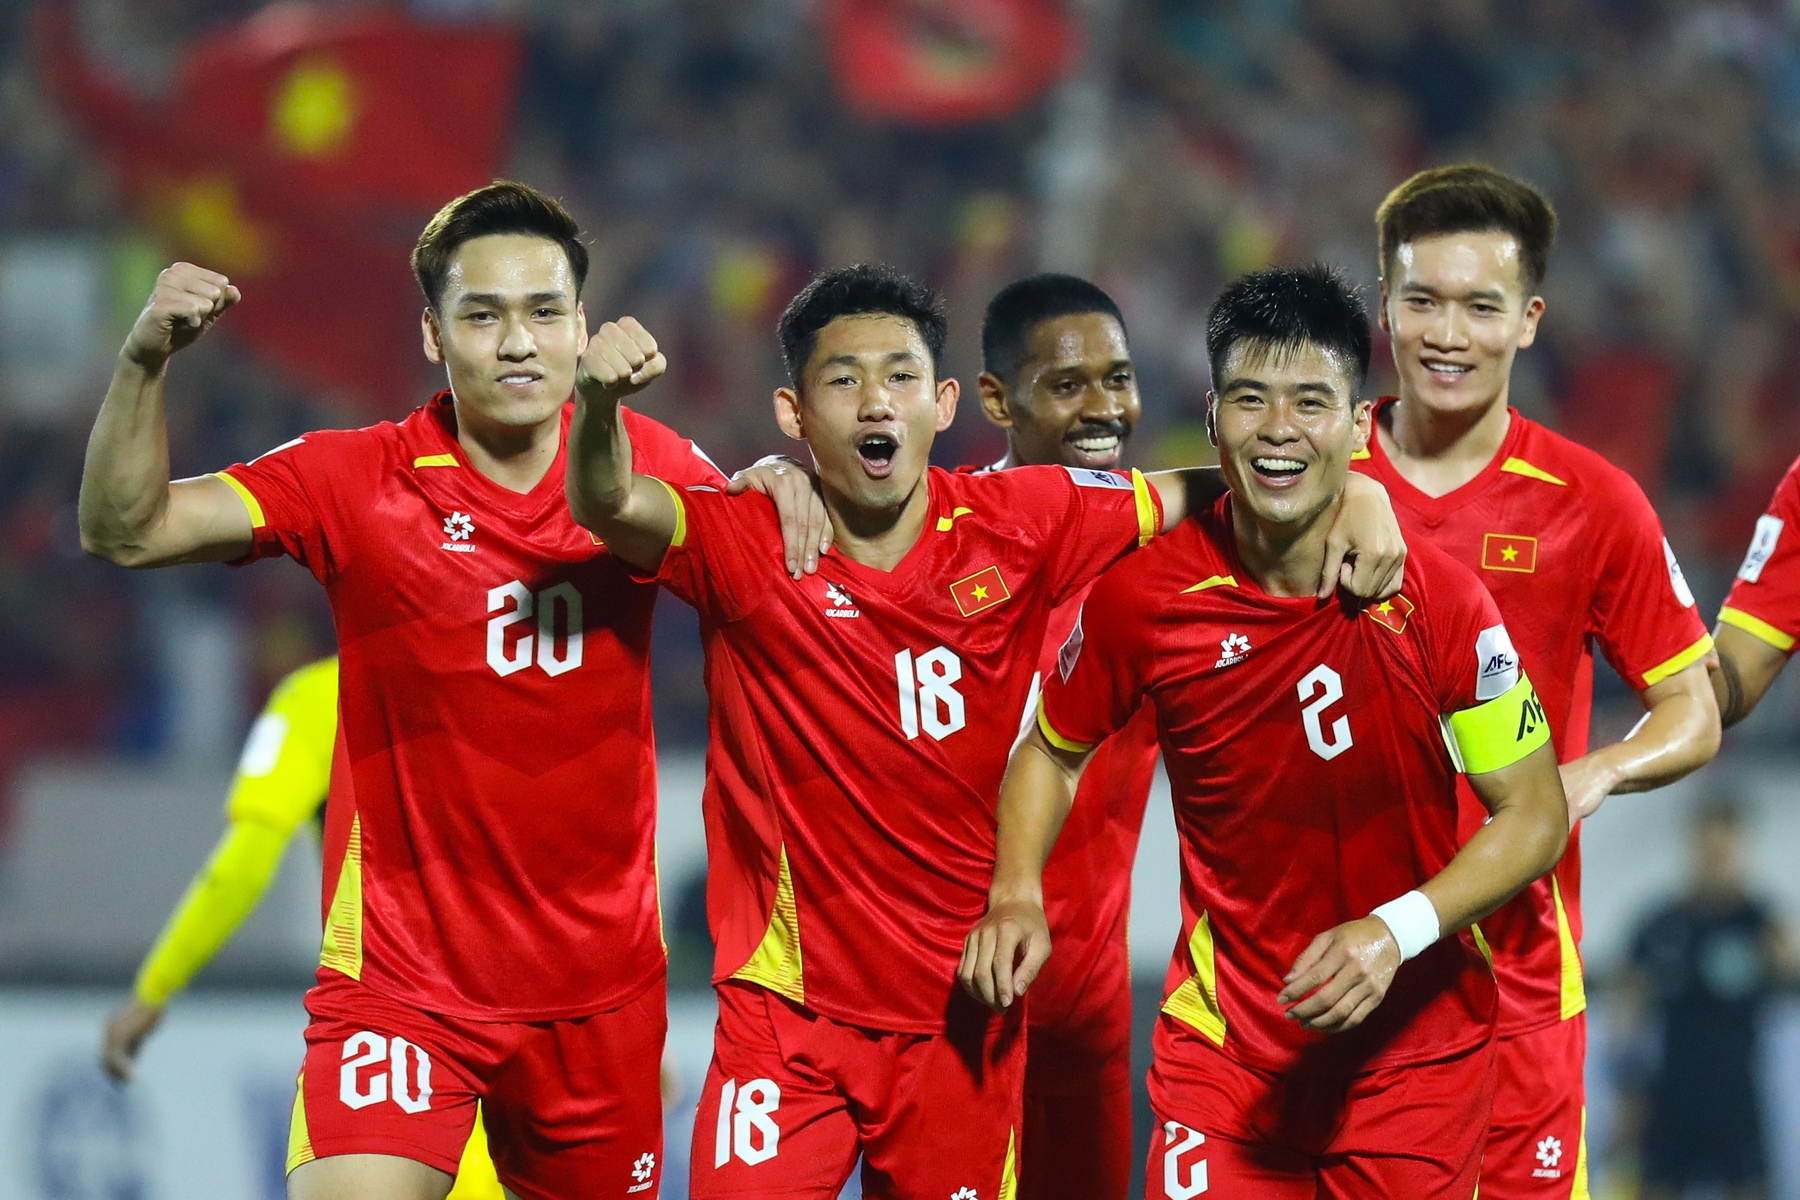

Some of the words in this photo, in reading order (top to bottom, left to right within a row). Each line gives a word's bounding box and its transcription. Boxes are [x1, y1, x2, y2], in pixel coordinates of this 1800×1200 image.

[486, 579, 583, 678] 20
[894, 645, 966, 742] 18
[1296, 663, 1354, 761] 2
[339, 1030, 433, 1114] 20
[714, 1077, 782, 1170] 18
[1163, 1120, 1209, 1200] 2
